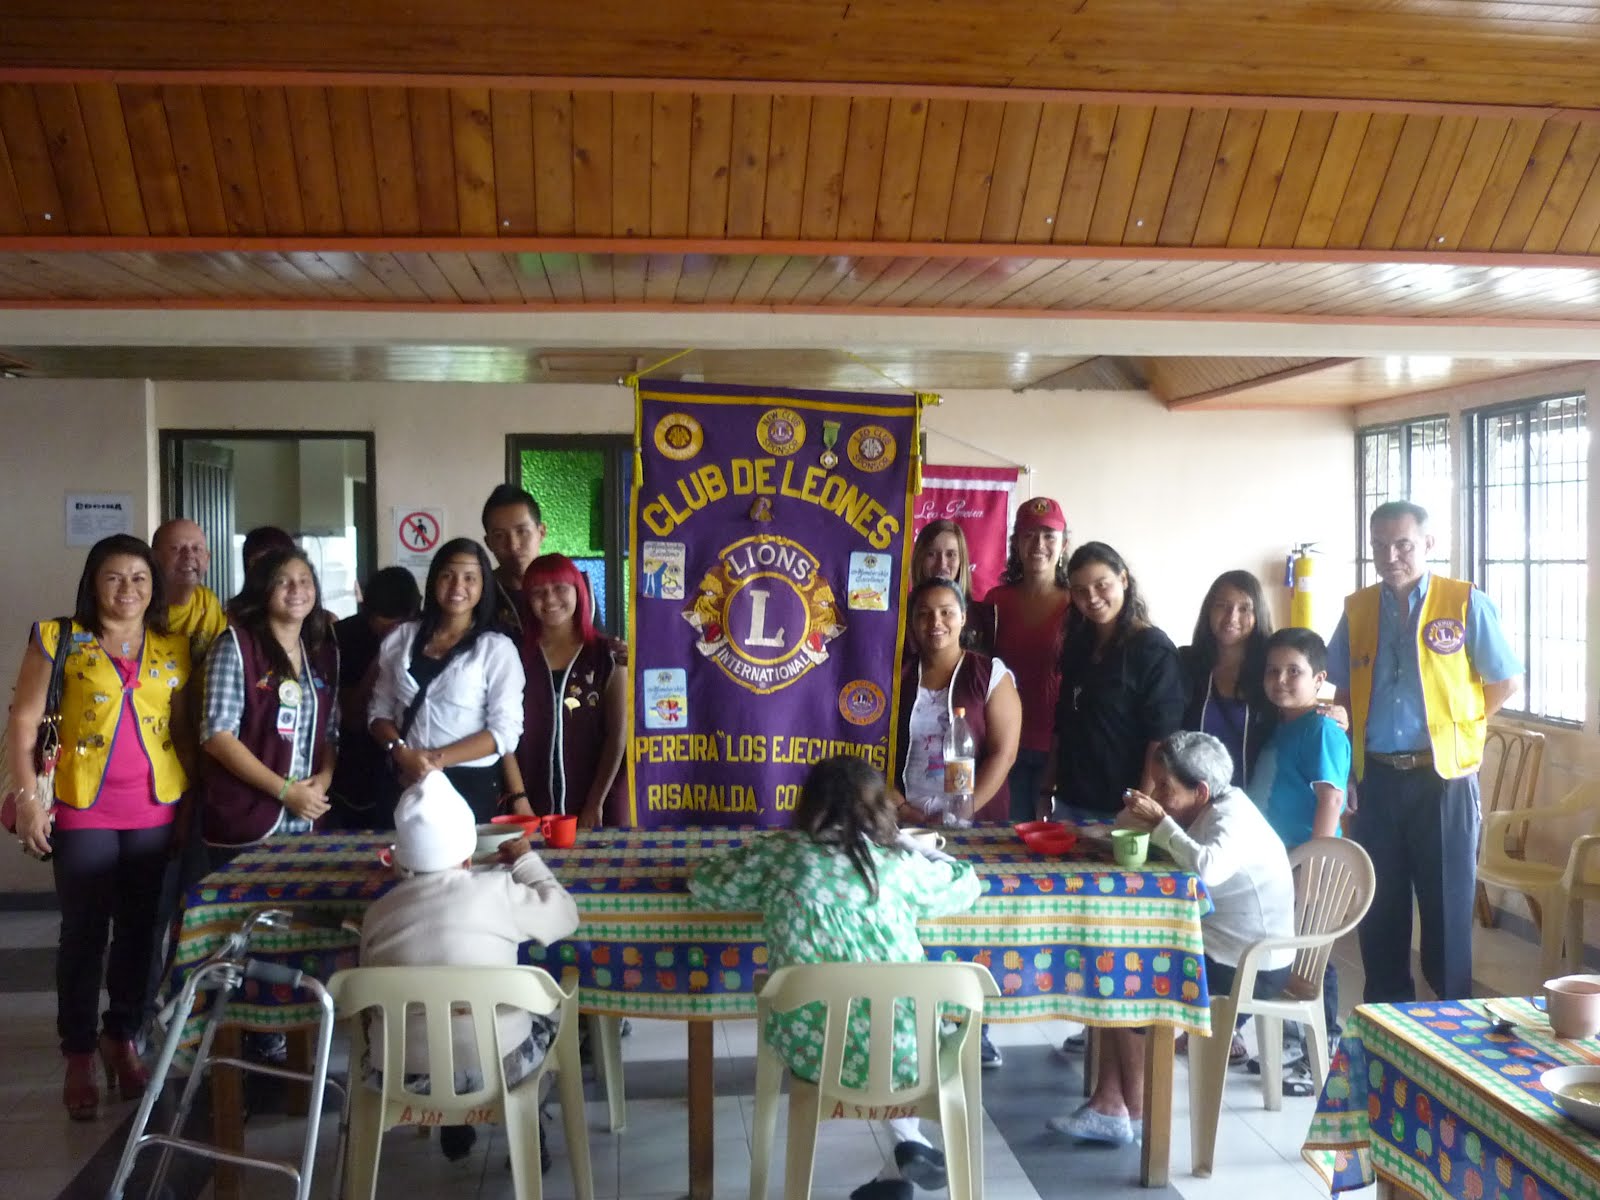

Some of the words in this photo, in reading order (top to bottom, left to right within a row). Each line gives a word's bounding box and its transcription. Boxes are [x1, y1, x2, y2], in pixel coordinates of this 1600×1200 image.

[642, 463, 728, 537] CLUB
[731, 458, 777, 495] DE
[780, 460, 900, 550] LEONES
[728, 544, 812, 580] LIONS
[744, 589, 785, 648] L
[716, 648, 811, 682] INTERNATIONAL
[636, 733, 719, 763] PEREIRA
[648, 783, 765, 815] RISARALDA,
